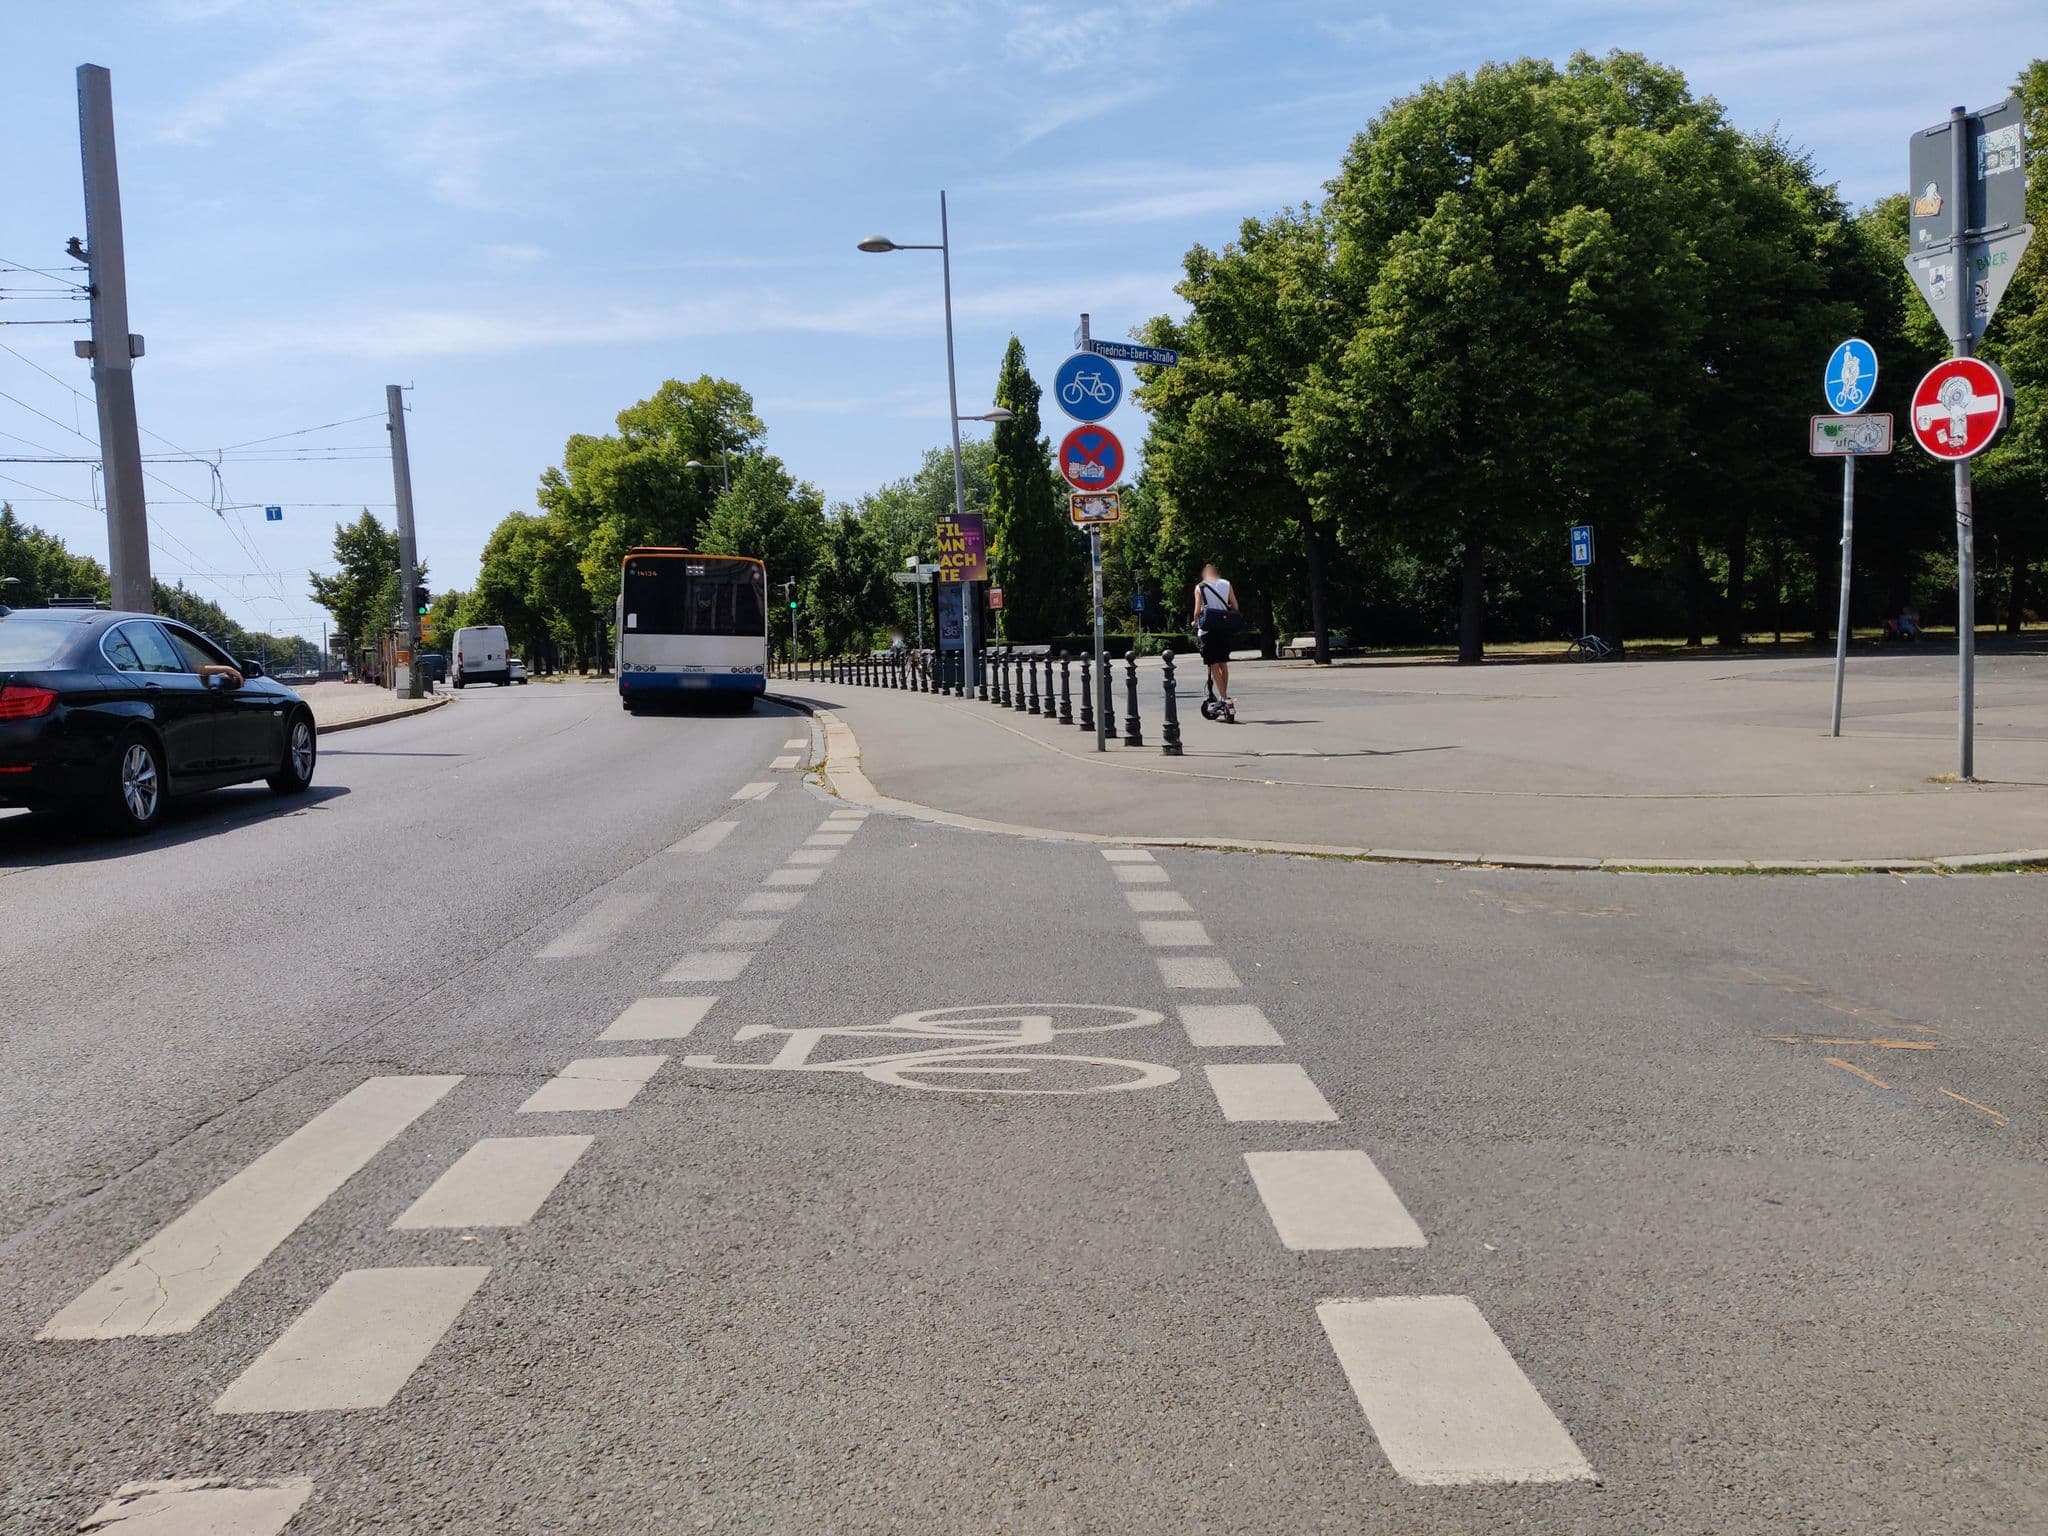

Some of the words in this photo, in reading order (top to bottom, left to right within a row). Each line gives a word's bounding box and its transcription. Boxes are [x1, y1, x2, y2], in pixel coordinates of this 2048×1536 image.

[1095, 343, 1174, 363] Friedrich-Ebert-Straße
[937, 523, 964, 537] FIL
[938, 538, 966, 552] MN
[940, 553, 977, 567] ACH
[941, 569, 961, 582] TE
